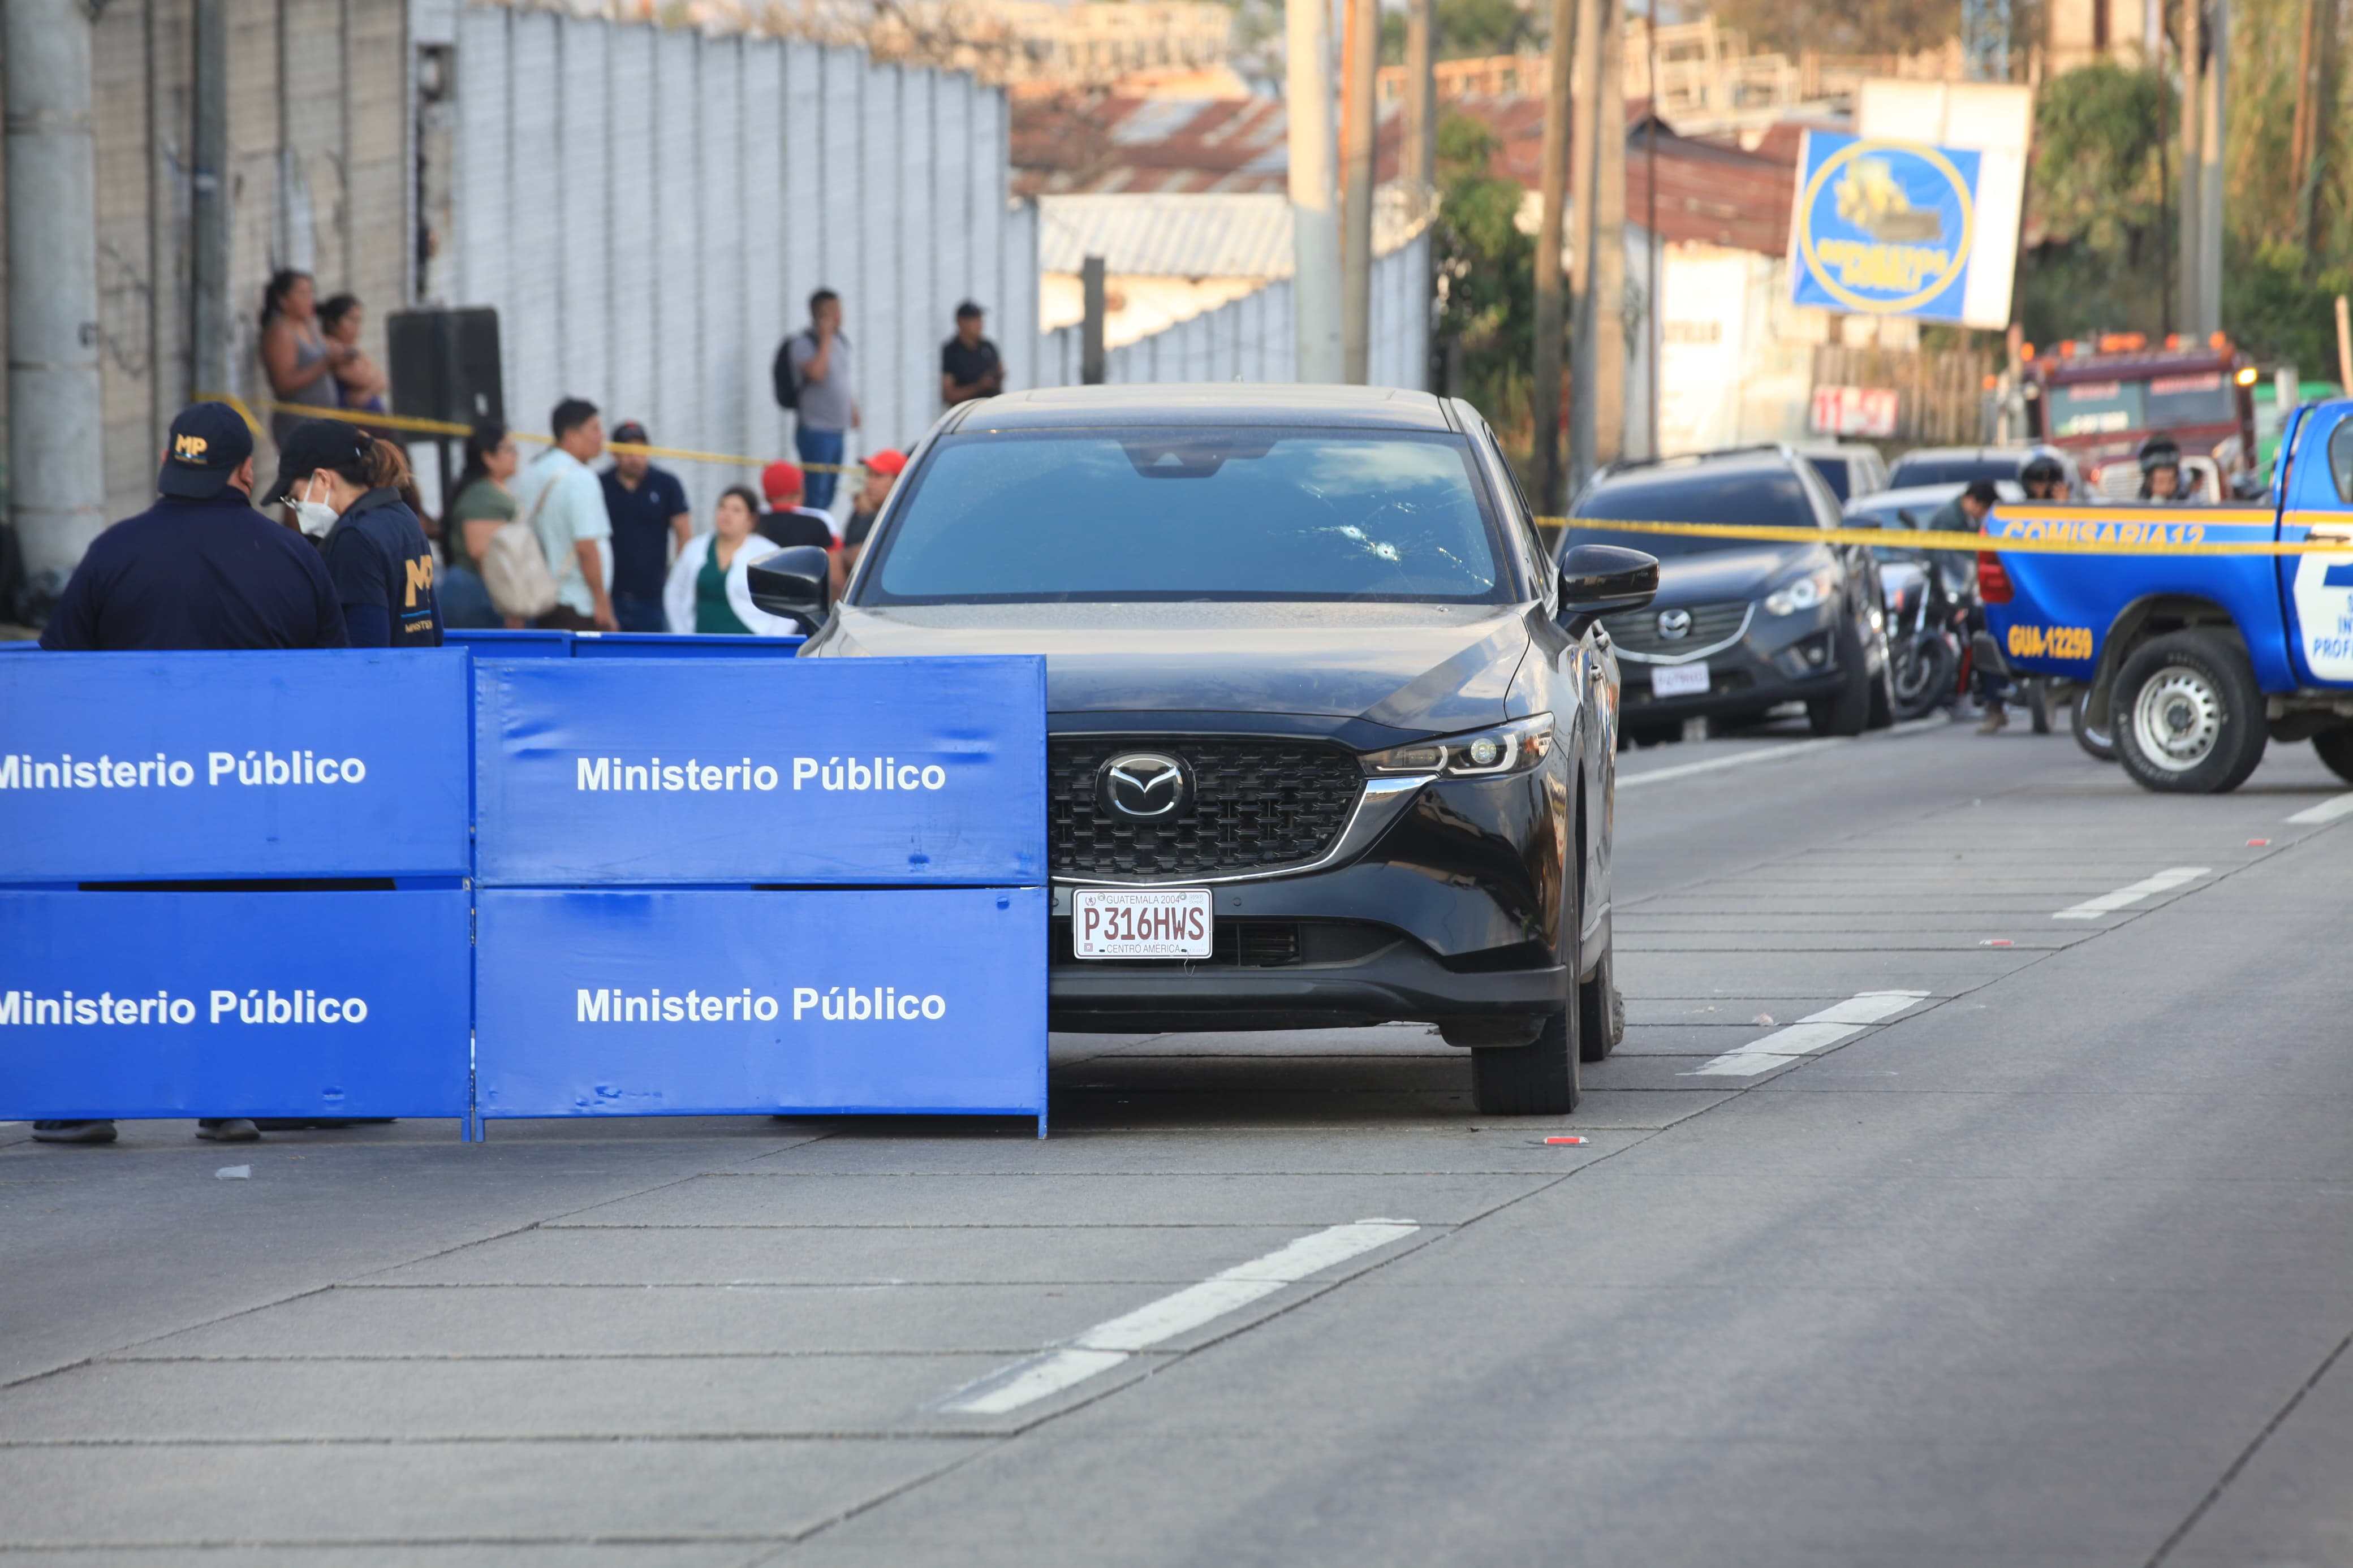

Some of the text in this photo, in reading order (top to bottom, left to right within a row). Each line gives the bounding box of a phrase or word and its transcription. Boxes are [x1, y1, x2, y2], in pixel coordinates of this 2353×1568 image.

[175, 433, 208, 456] MP
[2313, 637, 2353, 659] PROF
[208, 750, 366, 785] Público
[577, 757, 946, 791] Ministerio Público
[1106, 895, 1159, 905] GUATEMALA
[1161, 895, 1180, 905] 2004
[1106, 944, 1141, 953] CENTRO
[210, 990, 368, 1024] Público
[577, 987, 946, 1022] Ministerio Público
